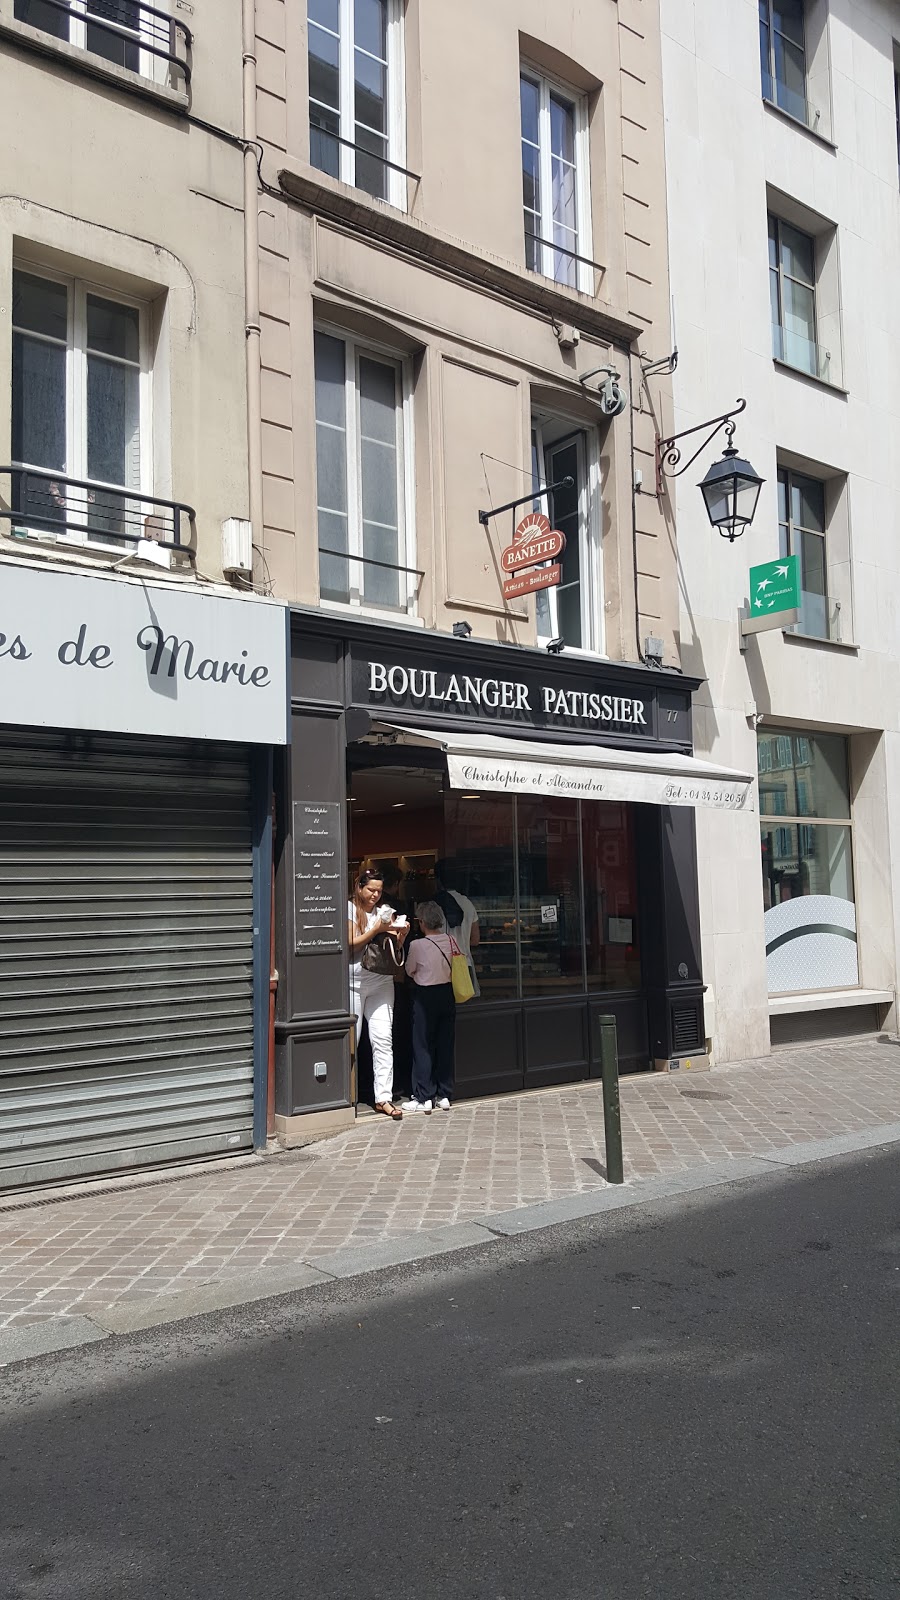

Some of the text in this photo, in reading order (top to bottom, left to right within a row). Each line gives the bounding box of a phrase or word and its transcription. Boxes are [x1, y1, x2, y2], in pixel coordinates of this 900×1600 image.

[507, 538, 556, 565] BANETTE
[505, 582, 524, 593] Artisan
[530, 571, 558, 584] Boulanger
[774, 587, 793, 595] PARIBAS
[57, 623, 114, 669] de
[136, 624, 272, 688] Marie
[368, 662, 647, 725] BOULANGER PATISSIER
[461, 765, 605, 792] Christophe et Alexandra
[665, 785, 683, 799] Tel
[701, 790, 711, 801] 34
[724, 792, 735, 803] 20
[735, 793, 746, 803] 50
